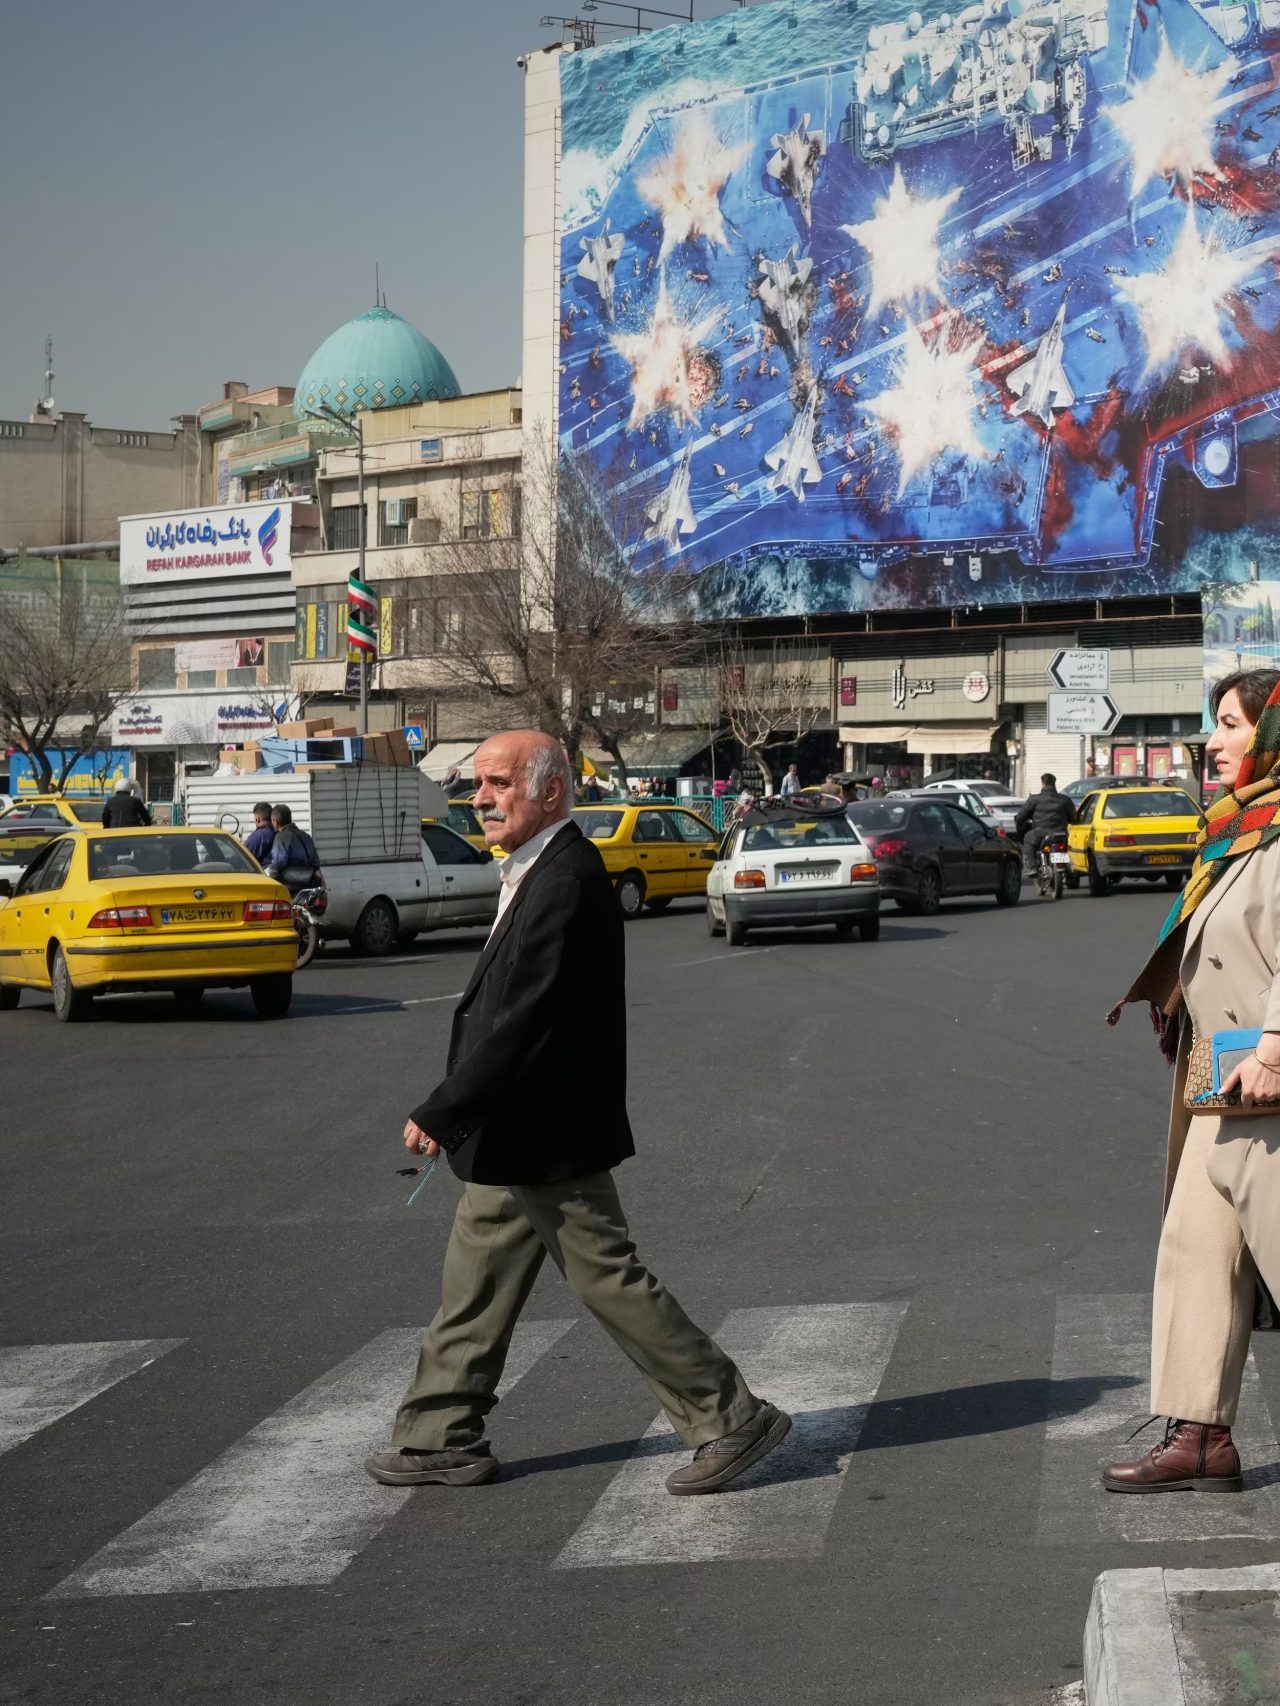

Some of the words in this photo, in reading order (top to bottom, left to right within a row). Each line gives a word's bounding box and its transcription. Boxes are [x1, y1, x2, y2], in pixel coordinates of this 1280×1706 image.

[146, 520, 187, 551] کارگران
[186, 517, 218, 547] رفاه
[218, 516, 251, 546] بانک
[146, 558, 175, 573] REFAH
[175, 552, 226, 570] KARGARAN
[225, 550, 252, 566] BANK
[1077, 663, 1096, 671] آزادی
[909, 679, 935, 699] کفش
[169, 911, 184, 921] ۷۸
